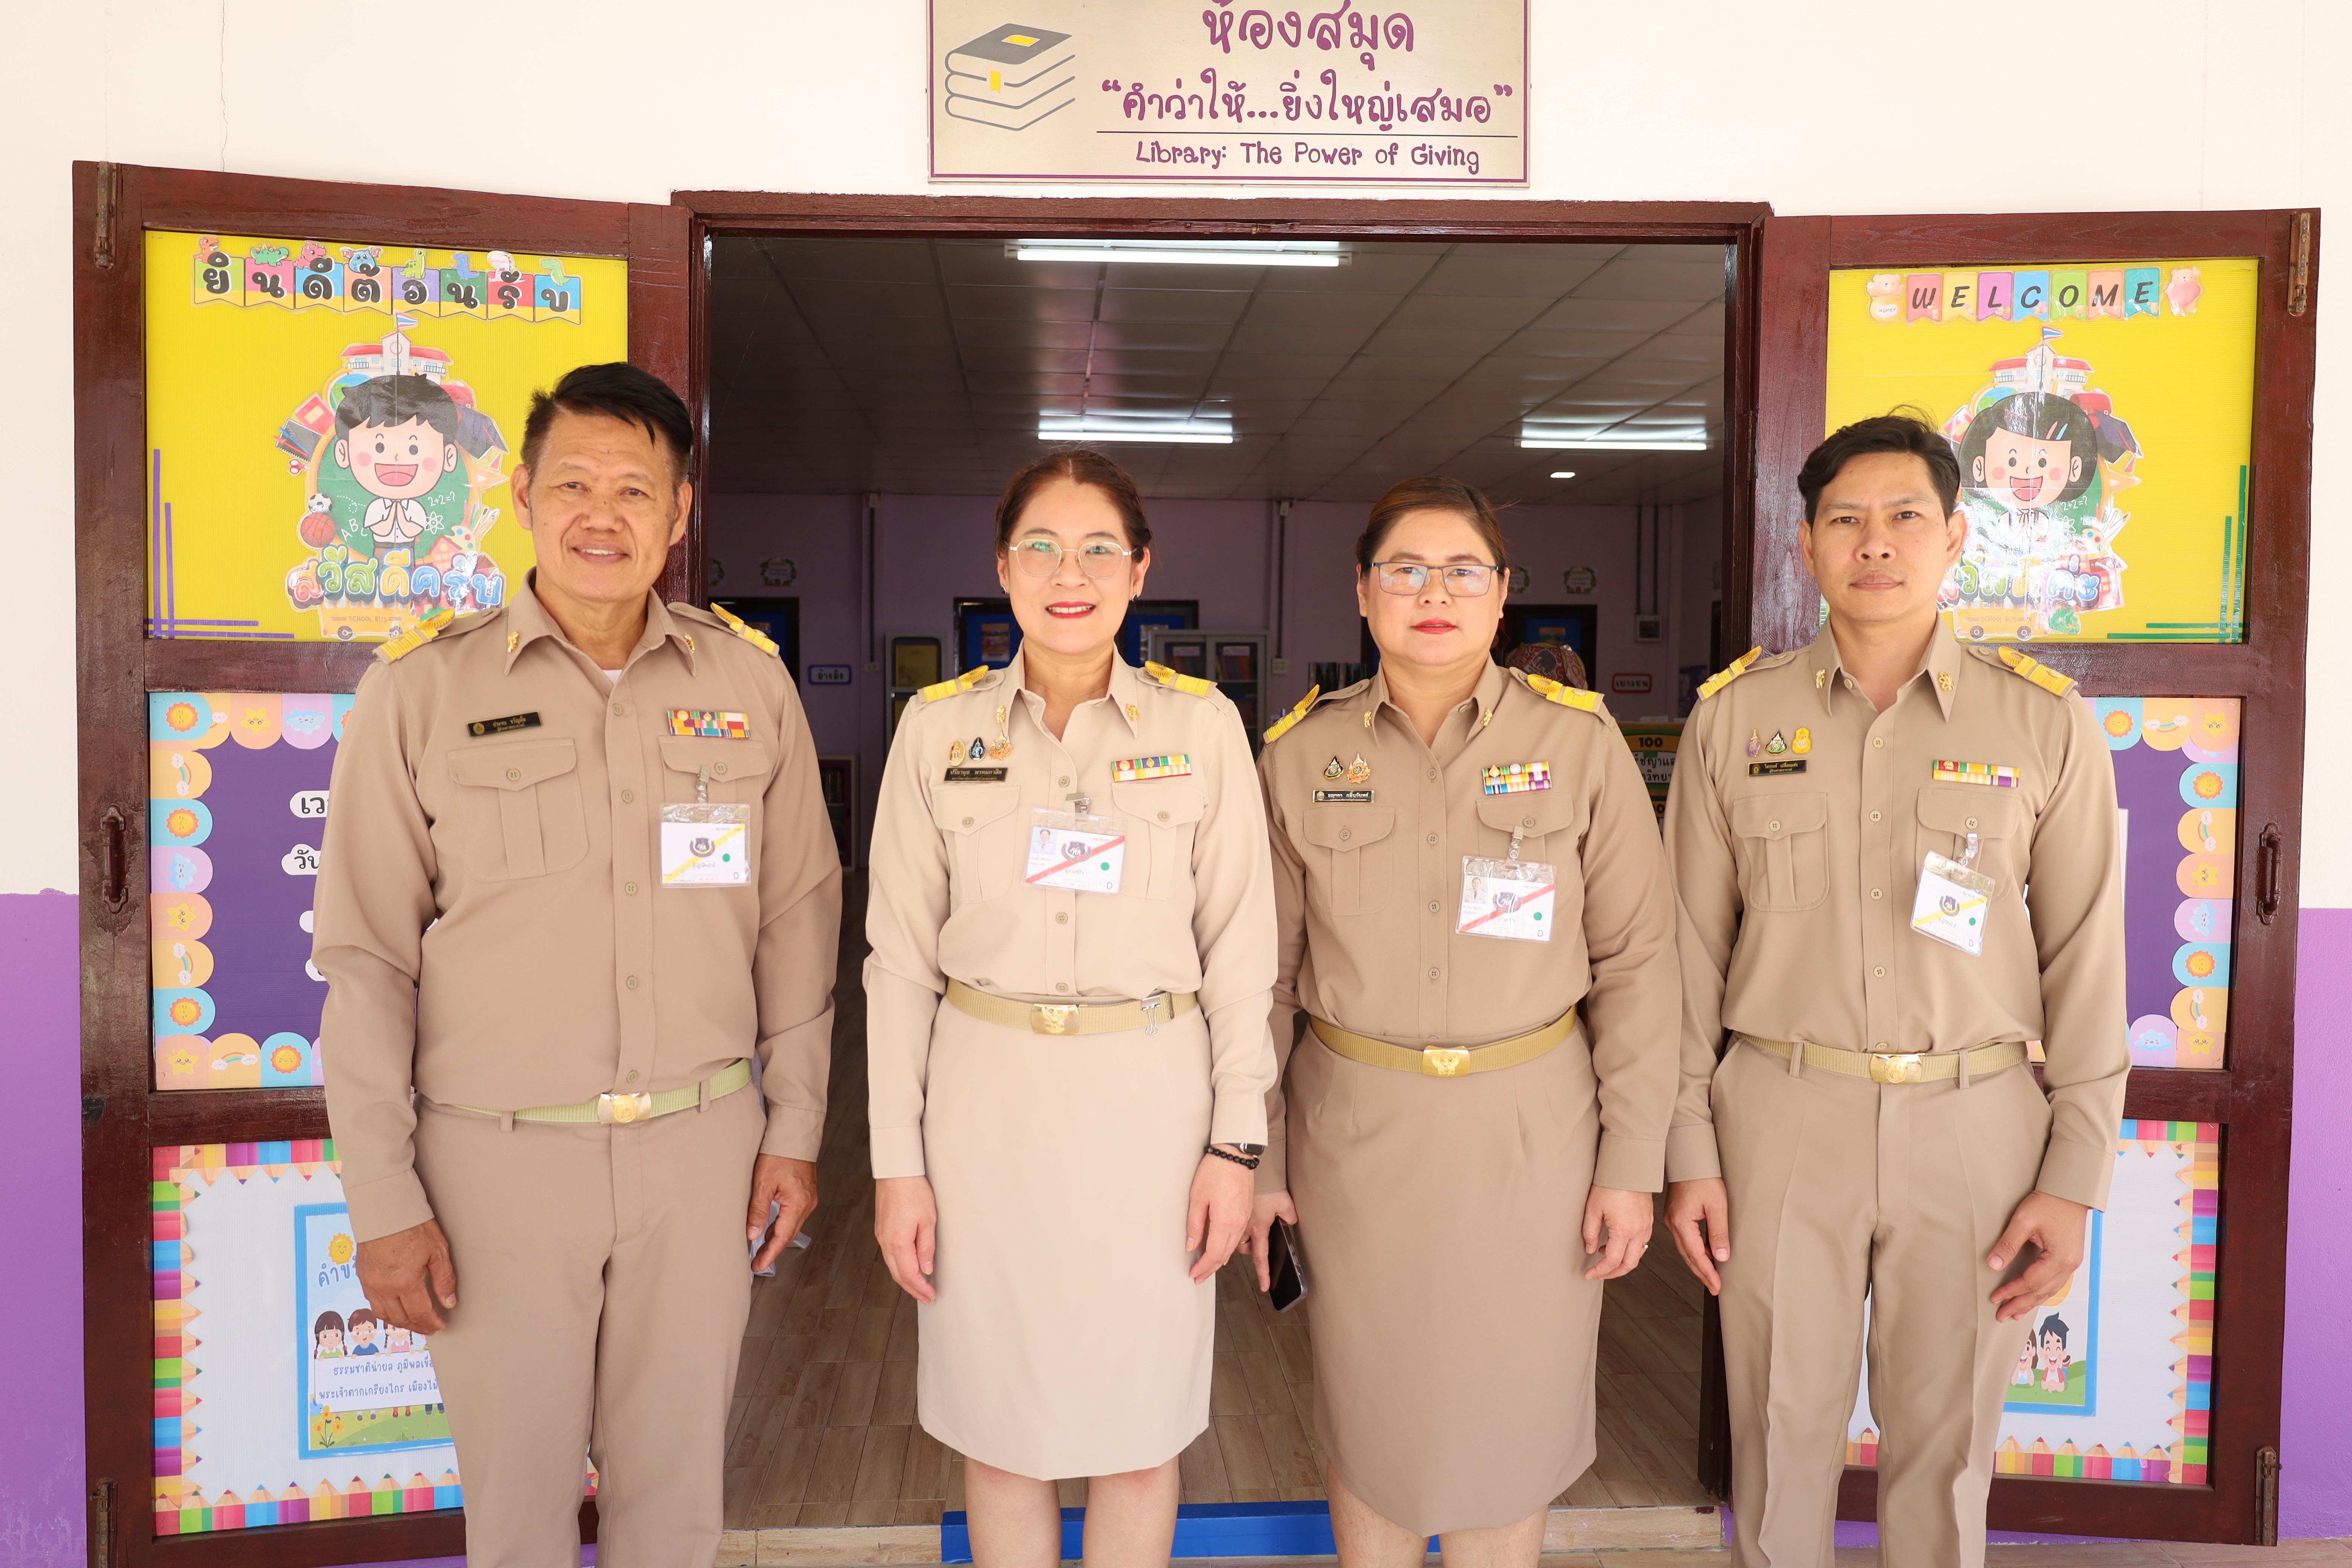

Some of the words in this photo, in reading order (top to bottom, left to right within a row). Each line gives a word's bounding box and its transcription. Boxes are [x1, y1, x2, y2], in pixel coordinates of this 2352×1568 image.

[1202, 0, 1414, 71] หองสมุด
[1136, 141, 1227, 169] Library:
[1240, 142, 1282, 164] The
[1295, 142, 1363, 165] Power
[1375, 143, 1398, 165] of
[1411, 145, 1479, 175] Giving
[203, 251, 568, 312] ยินดีต้อนรับ
[1912, 281, 2153, 309] WELCOME
[289, 545, 504, 606] สวัสดีครับ
[1638, 737, 1663, 747] 100
[302, 797, 329, 814] เว
[333, 1361, 393, 1375] ธรรมชาติน่ายล
[319, 1382, 404, 1399] พระเจ้าตากเกรียงไกร
